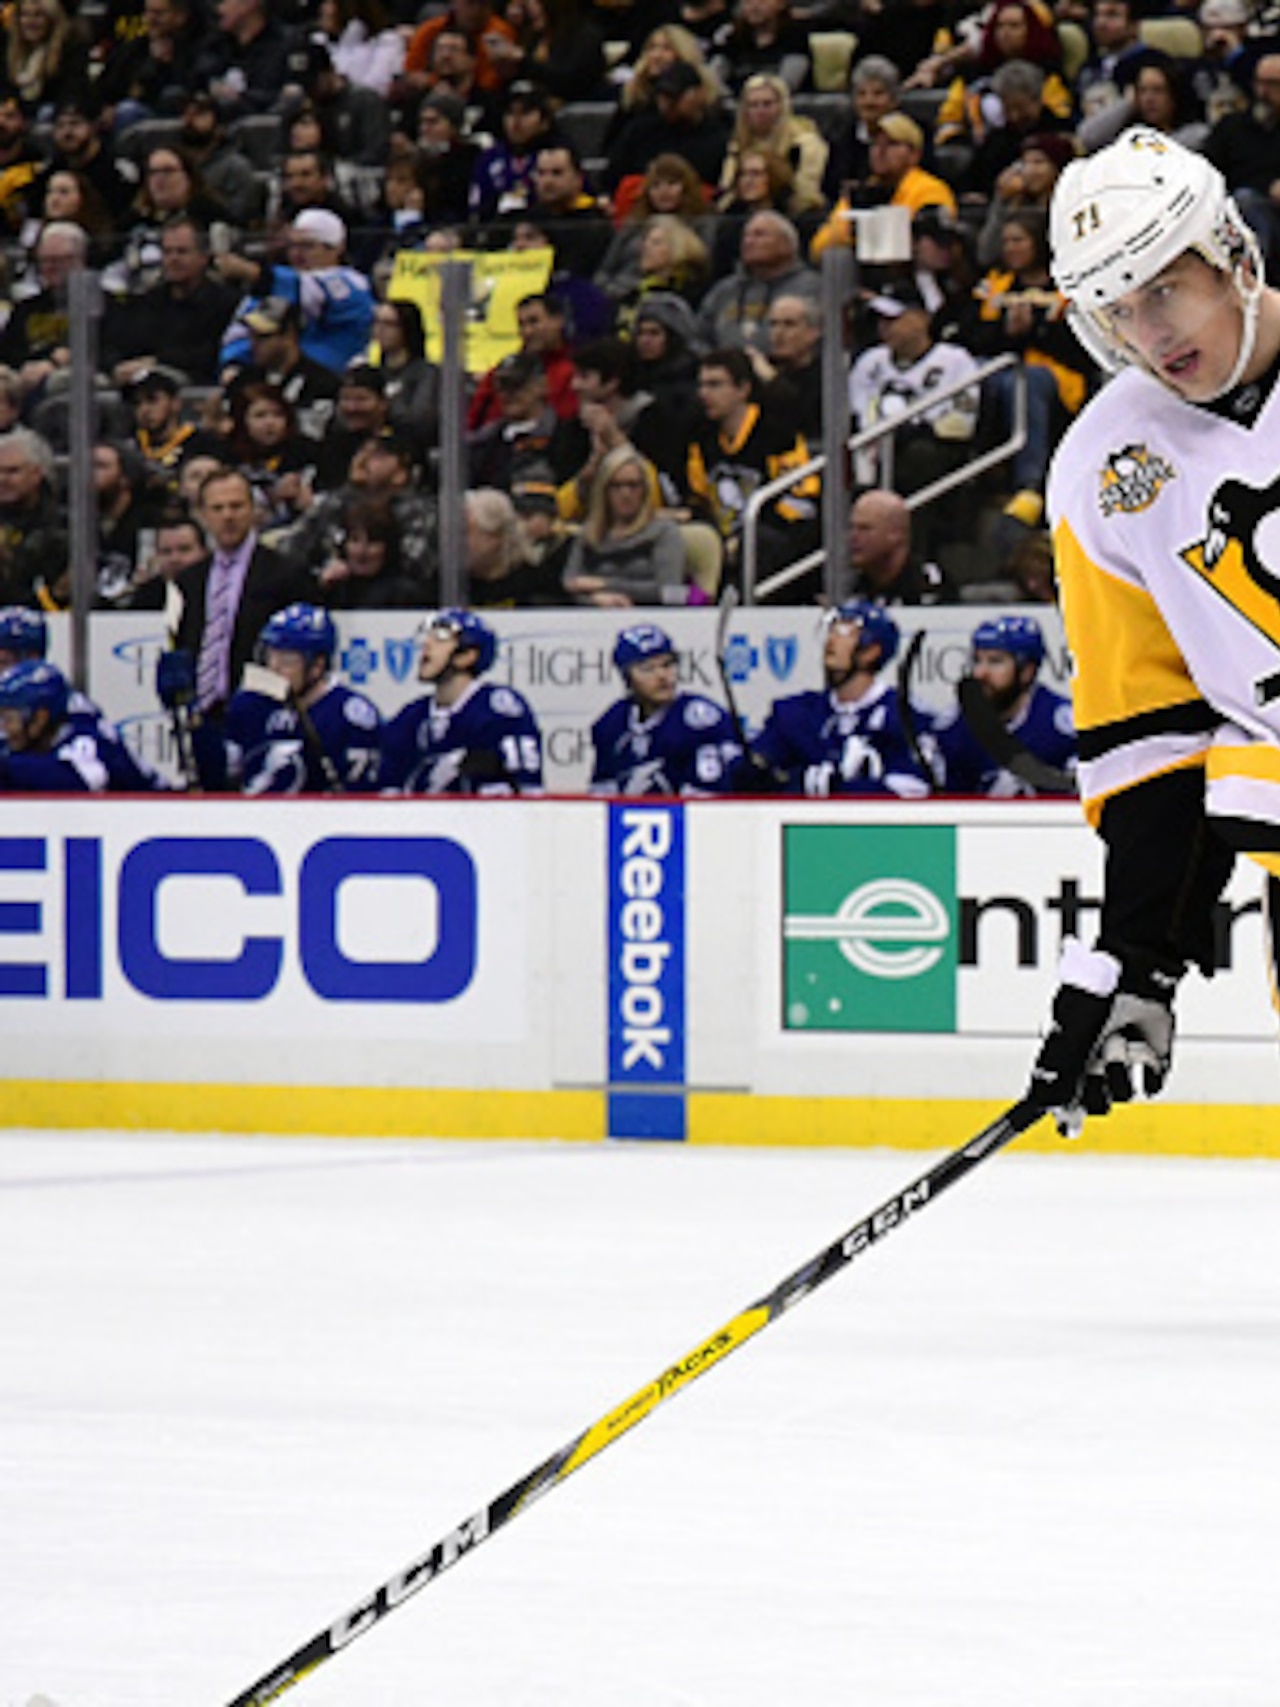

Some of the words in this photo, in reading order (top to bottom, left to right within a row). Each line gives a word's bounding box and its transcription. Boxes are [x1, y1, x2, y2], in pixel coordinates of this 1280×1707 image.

[501, 735, 541, 772] 15
[620, 809, 674, 1071] Reebok
[842, 1179, 929, 1258] CCM
[330, 1509, 489, 1652] CCM
